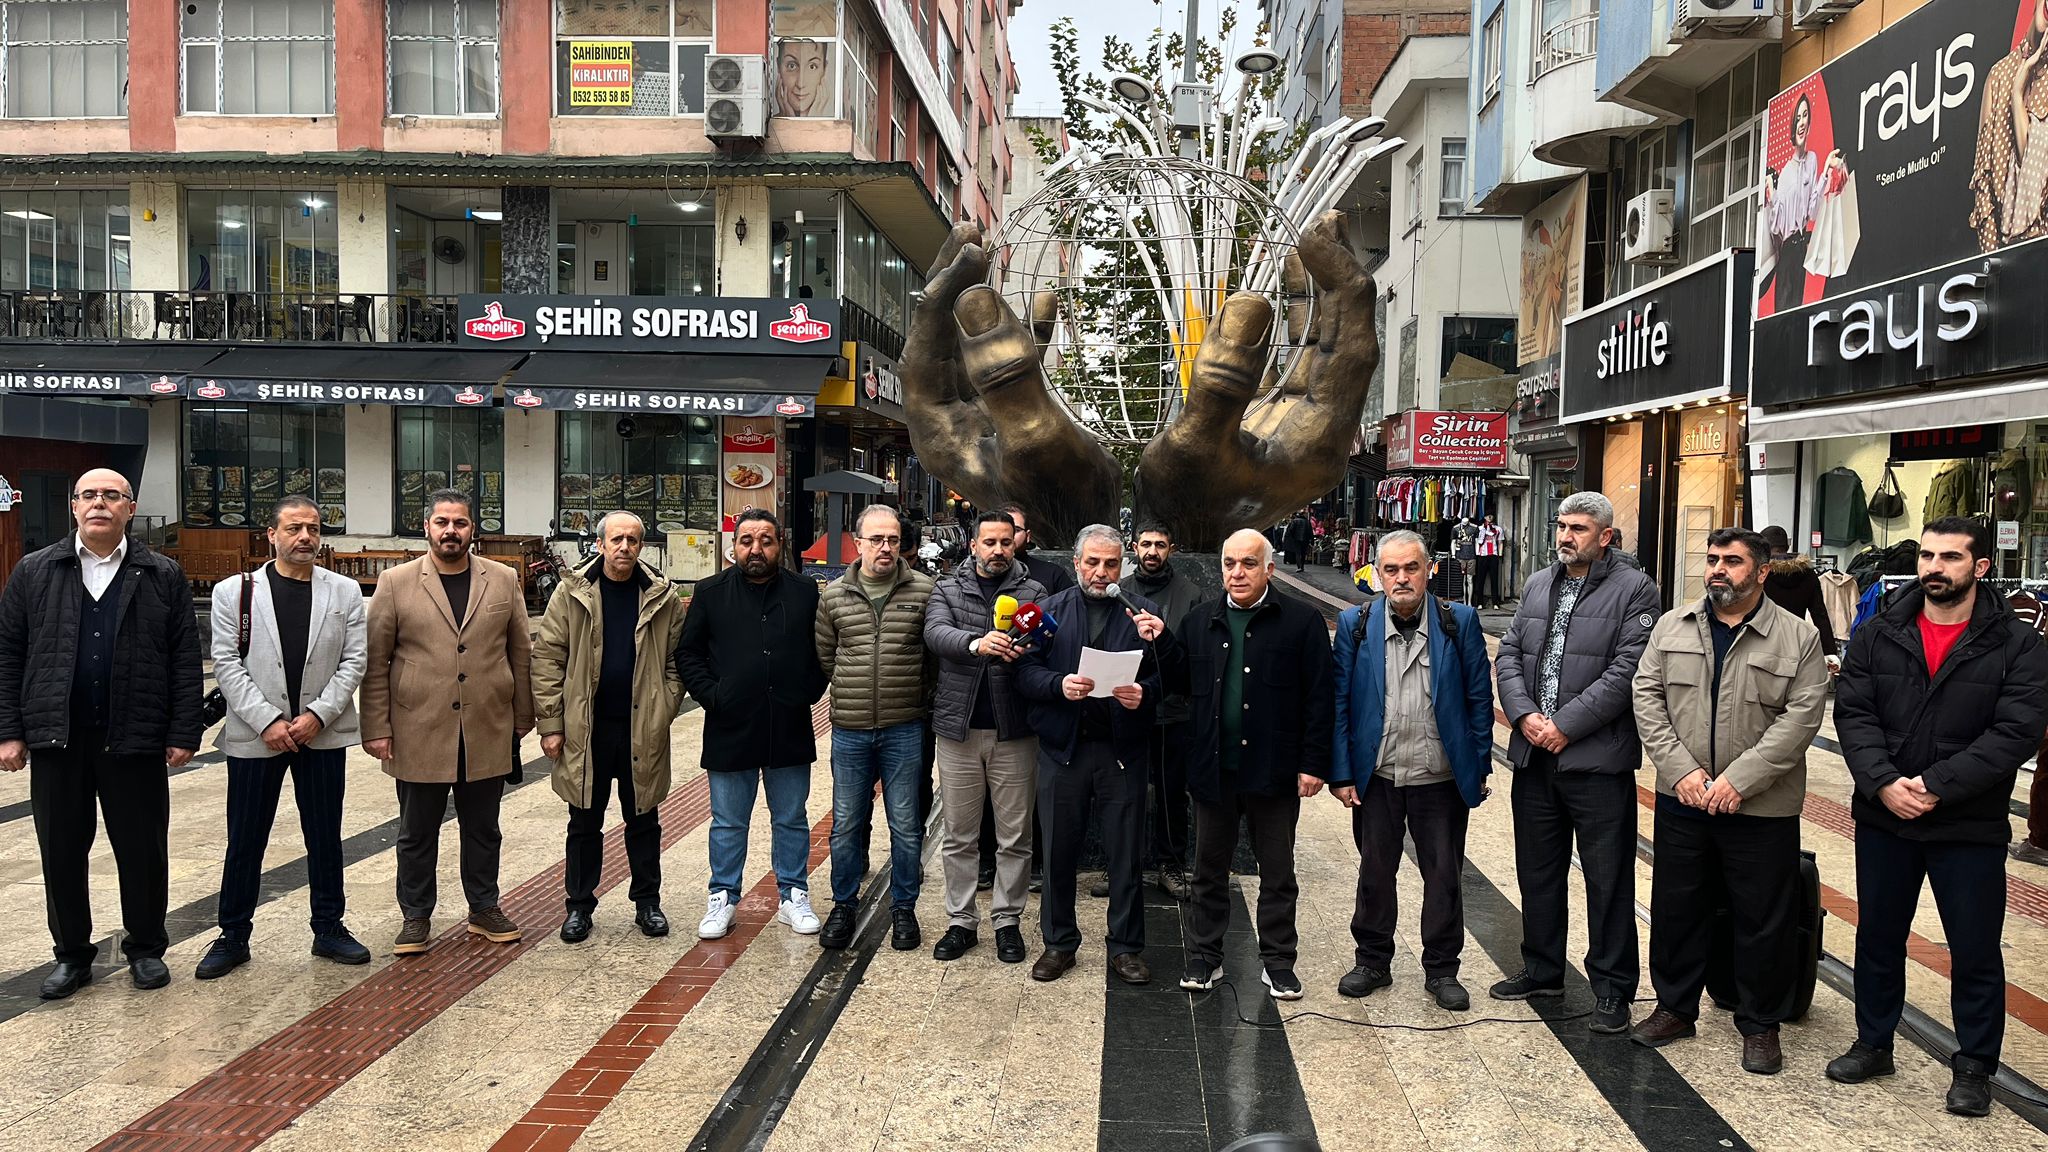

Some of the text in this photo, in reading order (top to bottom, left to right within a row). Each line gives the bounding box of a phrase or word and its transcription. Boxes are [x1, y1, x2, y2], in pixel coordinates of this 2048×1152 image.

[572, 44, 630, 60] SAHİBİNDEN
[573, 91, 629, 102] 0532 553 58 85
[1858, 32, 1975, 152] rays
[1896, 166, 1906, 178] de
[1908, 156, 1929, 174] Mutlu
[472, 322, 518, 335] şenpiliç
[536, 299, 758, 343] ŞEHİR SOFRASI
[776, 322, 823, 337] şenpiliç
[1807, 274, 1980, 370] rays
[1596, 302, 1668, 379] stilife
[32, 376, 120, 390] SOFRASI
[257, 382, 424, 400] ŞEHİR SOFRASI
[574, 392, 744, 410] ŞEHİR SOFRASI
[1431, 416, 1490, 436] Şirin
[1419, 434, 1500, 447] Collection
[1685, 422, 1720, 452] stilife
